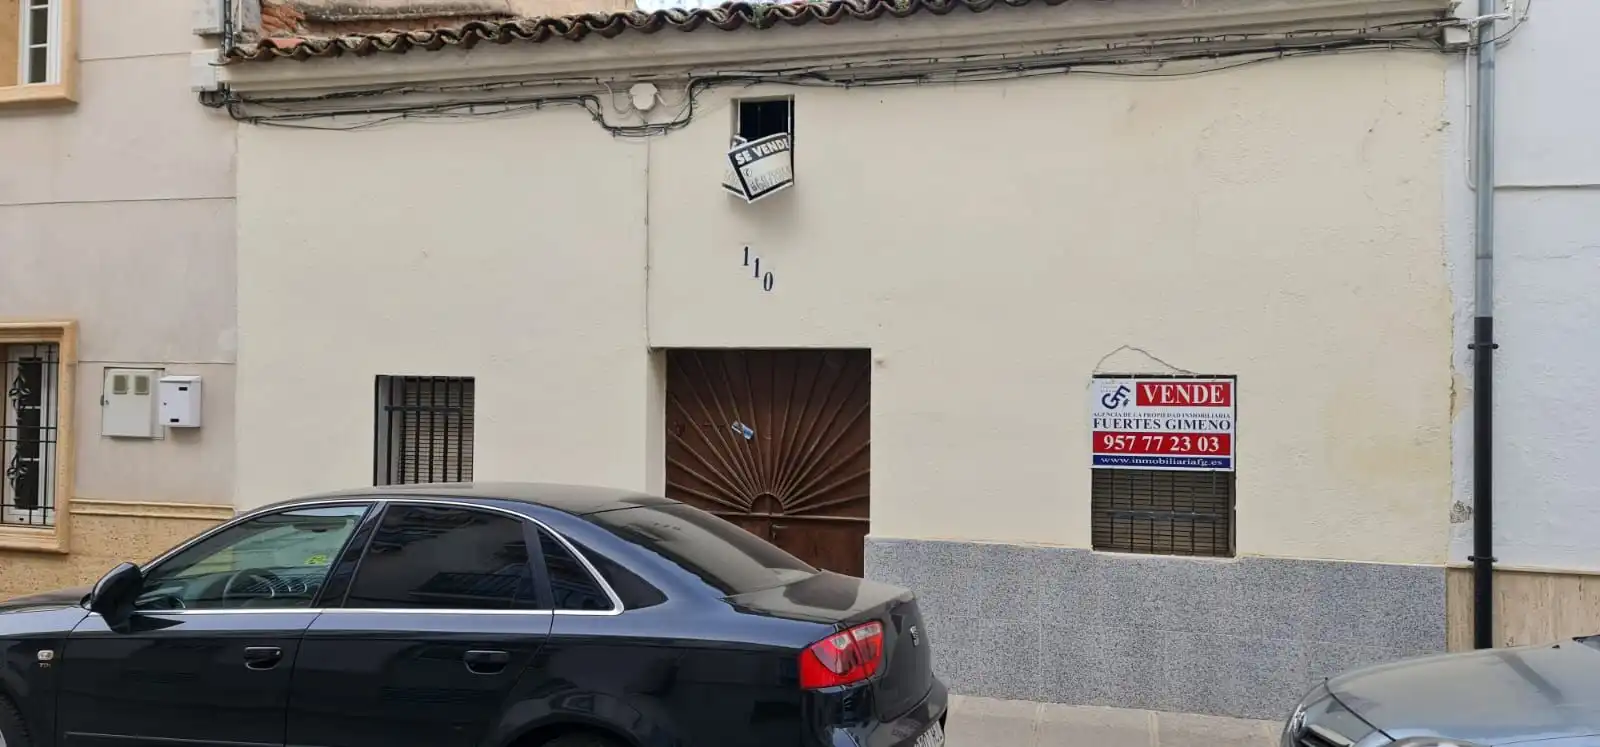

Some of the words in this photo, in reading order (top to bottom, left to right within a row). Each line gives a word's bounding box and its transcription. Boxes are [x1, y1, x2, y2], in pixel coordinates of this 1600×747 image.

[735, 149, 753, 166] SE
[744, 246, 773, 291] 110
[1143, 384, 1225, 404] VENDE
[1093, 418, 1161, 429] FUERTES
[1165, 418, 1231, 430] GIMENO
[1103, 434, 1136, 451] 957
[1141, 435, 1164, 451] 77
[1169, 436, 1191, 452] 23
[1197, 436, 1220, 452] 03
[1100, 456, 1223, 466] www.inmobiliariafg.es
